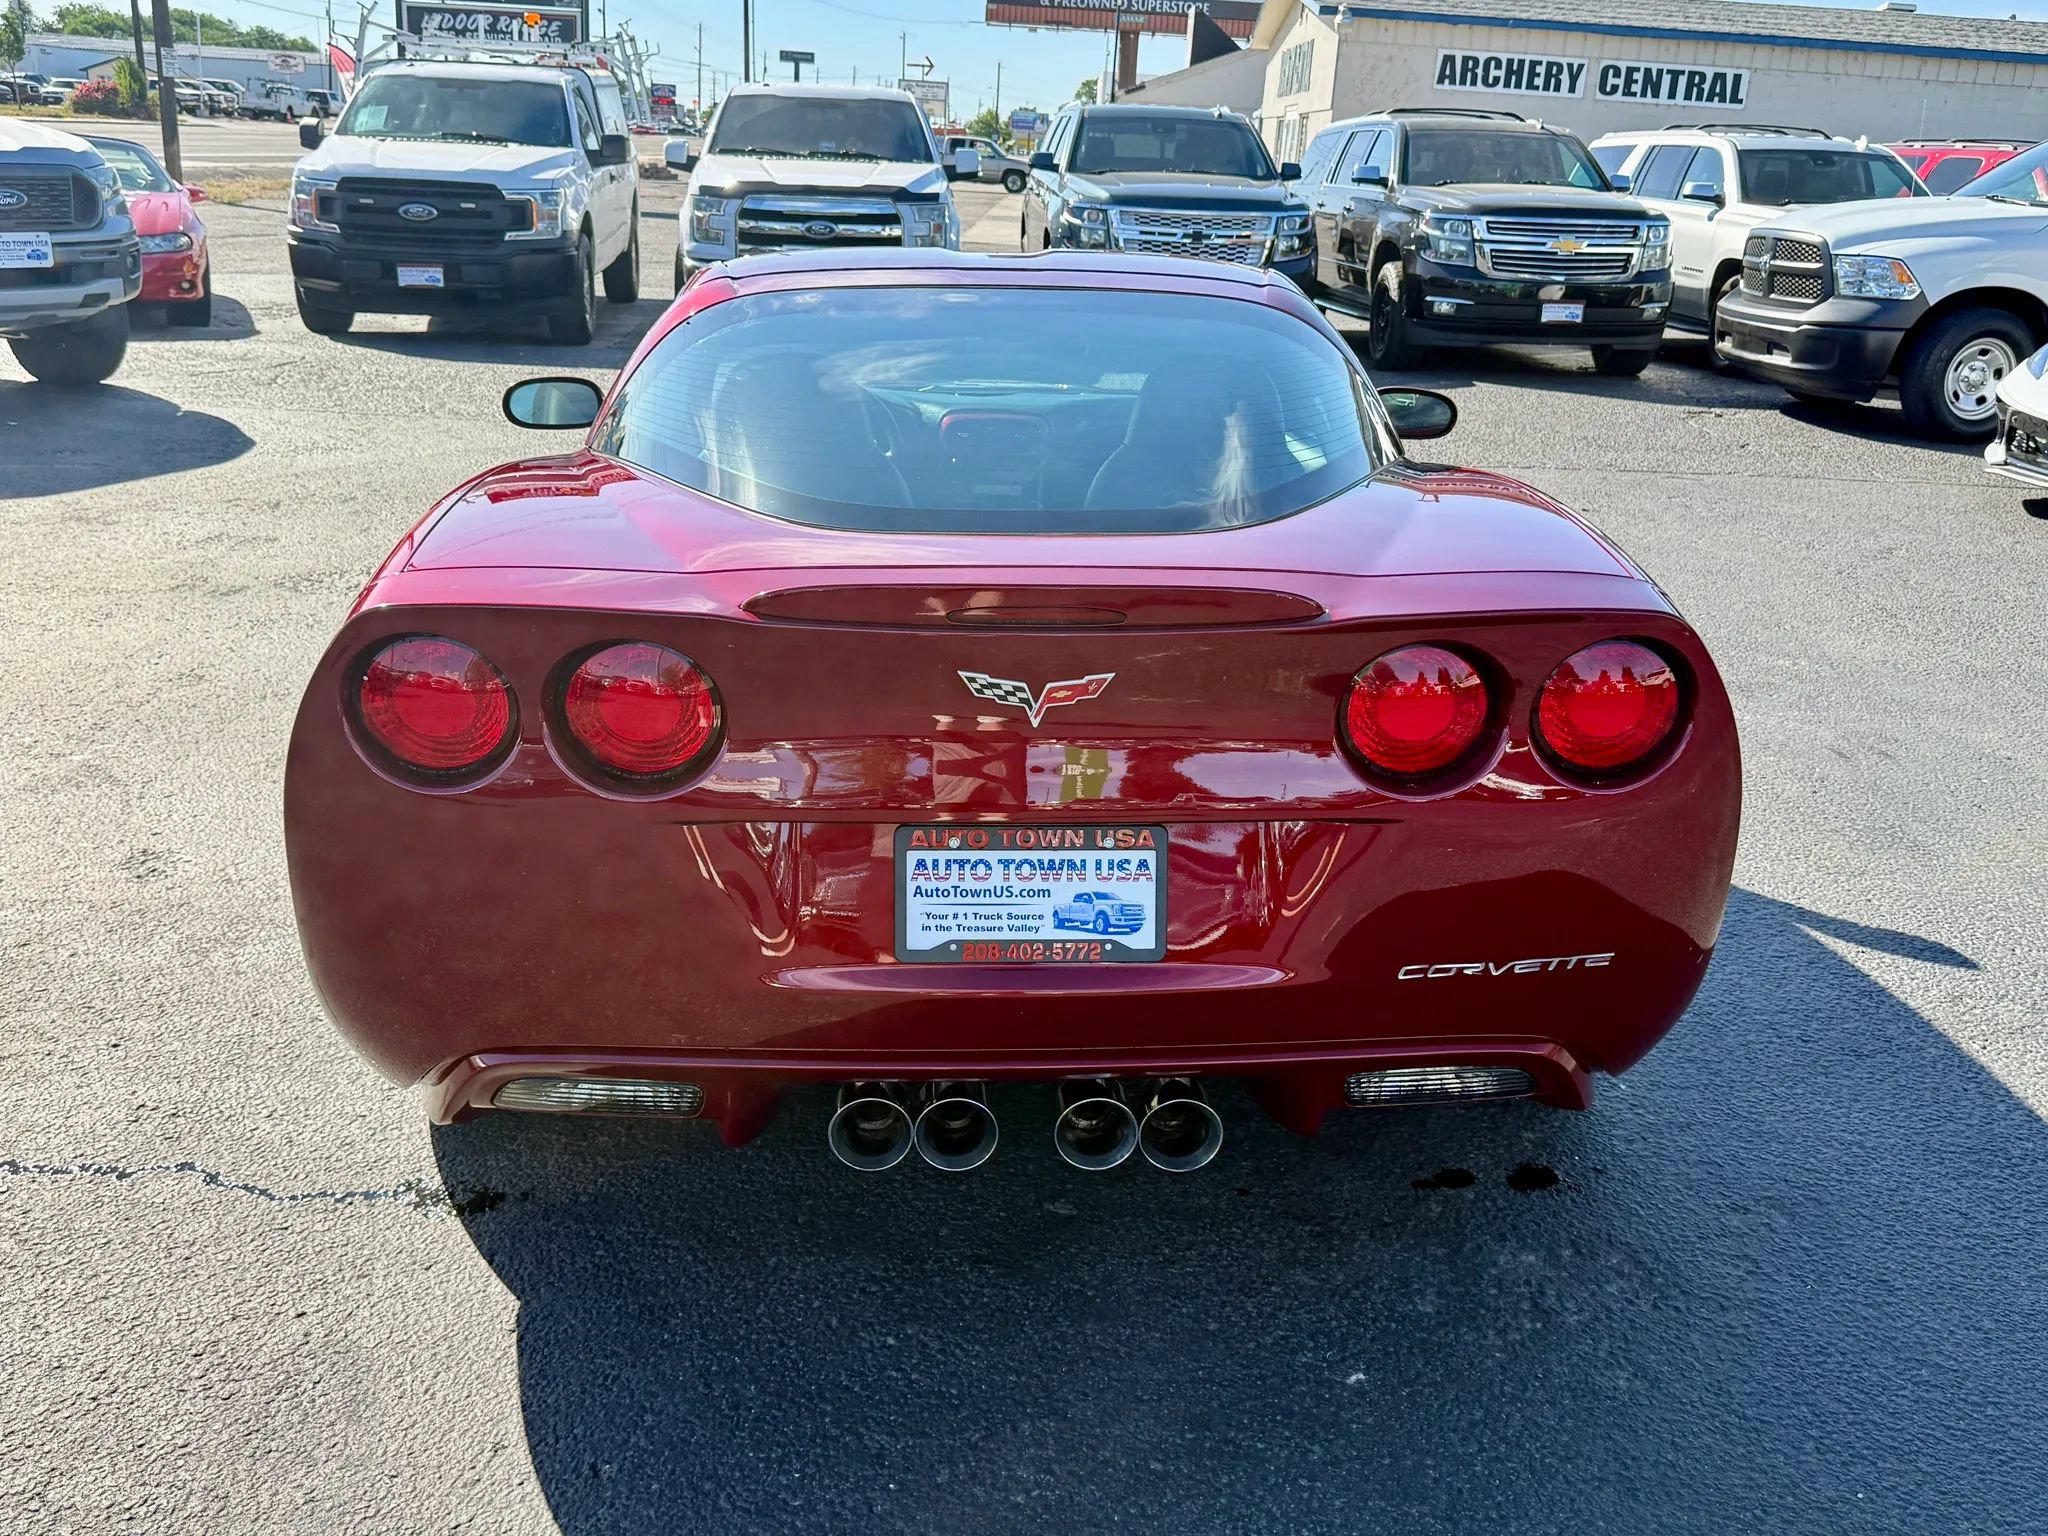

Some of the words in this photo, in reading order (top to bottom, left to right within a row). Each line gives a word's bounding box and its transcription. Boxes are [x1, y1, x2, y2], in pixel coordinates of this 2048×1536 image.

[1054, 0, 1128, 11] PREOWNED
[496, 15, 562, 37] RAGE
[1436, 54, 1585, 93] ARCHERY
[1598, 64, 1744, 105] CENTRAL
[12, 240, 34, 248] TOWN
[911, 829, 990, 848] AUTO
[997, 829, 1085, 848] TOWN
[1095, 829, 1155, 848] USA
[911, 858, 993, 882] AUTO
[997, 858, 1087, 882] TOWN
[1095, 858, 1154, 882] USA
[913, 885, 1051, 899] AutoTownUS.com
[952, 912, 959, 920] #
[963, 912, 968, 920] 1
[972, 912, 1003, 920] Truck
[1006, 912, 1044, 920] Source
[922, 924, 931, 932] in
[935, 924, 953, 932] the
[956, 924, 1004, 932] Treasure
[962, 943, 1102, 960] 208-402-5772
[1398, 952, 1615, 980] CORVETTE
